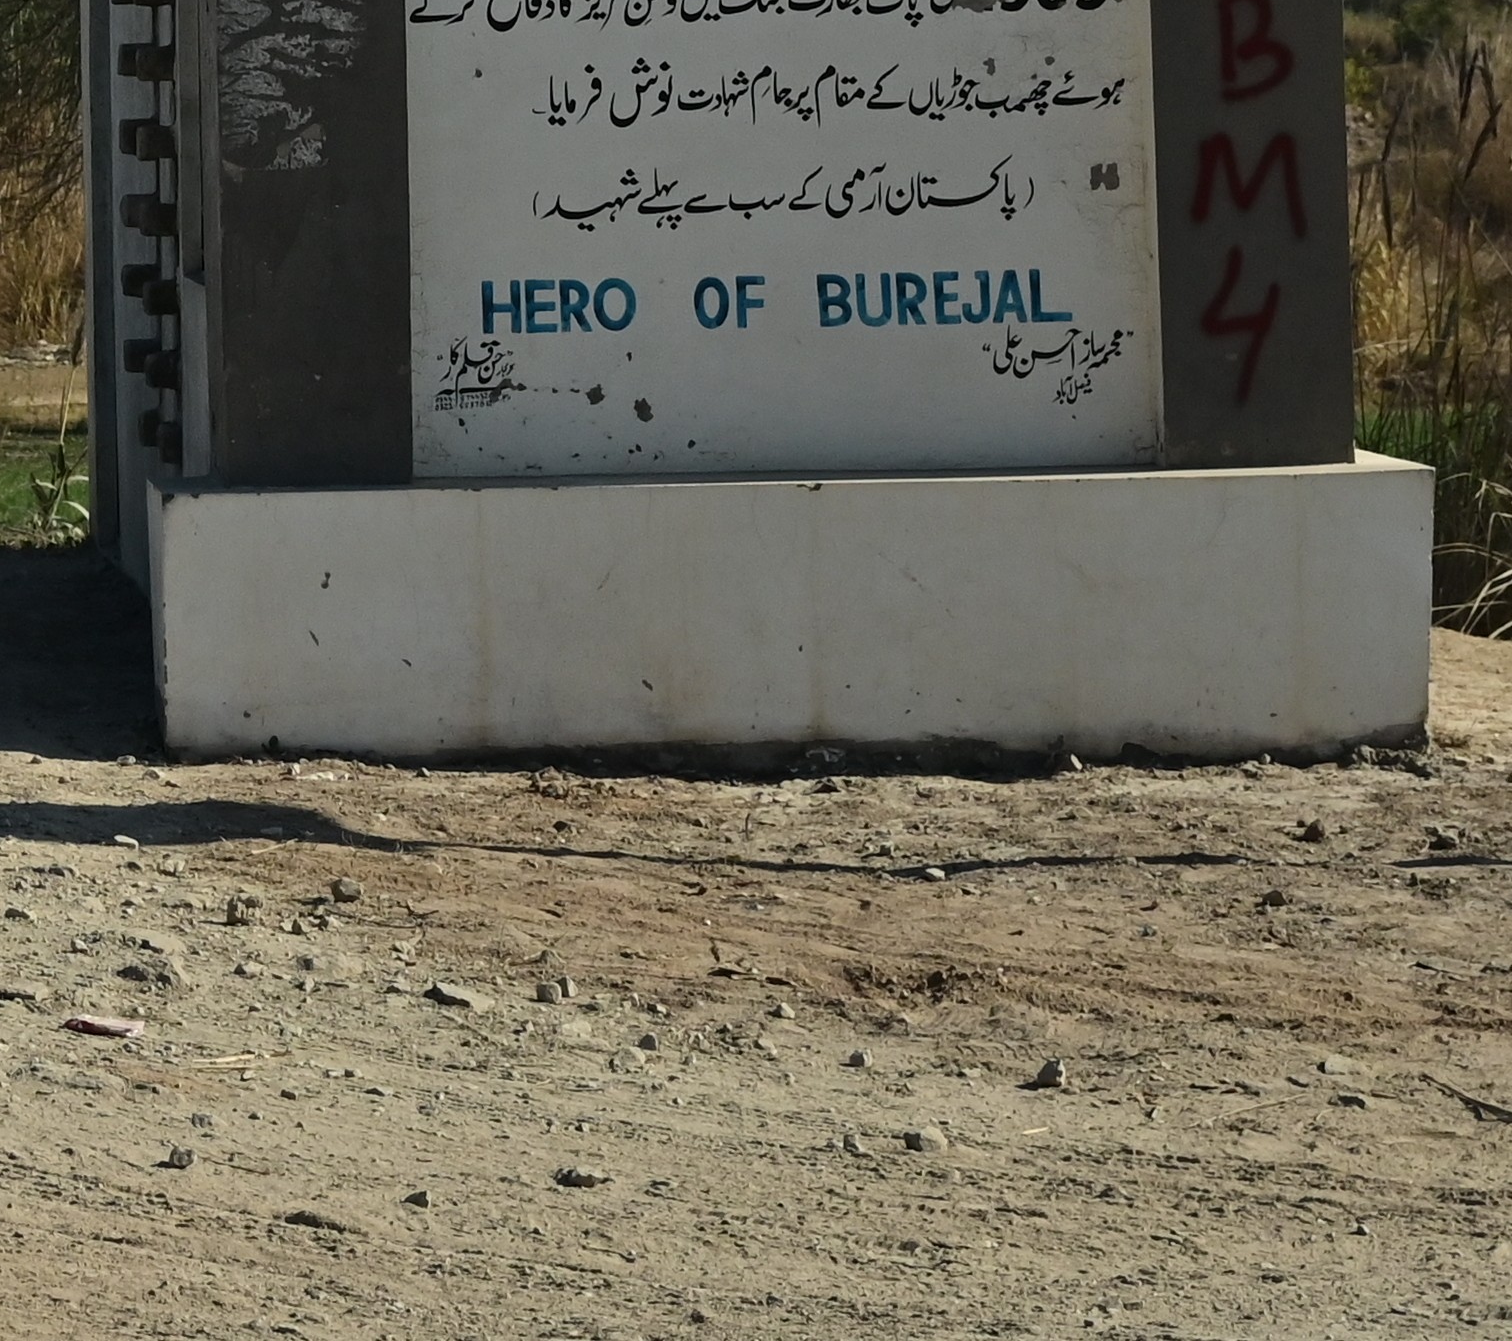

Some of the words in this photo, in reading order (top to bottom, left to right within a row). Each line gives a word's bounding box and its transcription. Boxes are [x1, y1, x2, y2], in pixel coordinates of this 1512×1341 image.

[609, 57, 673, 128] نوش
[677, 71, 749, 117] شہادت
[783, 86, 814, 121] پر
[814, 65, 866, 128] مقام
[867, 63, 906, 109] کے
[909, 67, 980, 121] جوڑیاں
[976, 79, 1052, 118] چھمب
[1052, 70, 1125, 109] ہوئے
[637, 167, 683, 230] پہلے
[683, 193, 729, 214] سے
[728, 193, 786, 220] سب
[788, 165, 823, 211] کے
[825, 162, 887, 219] آرمی
[480, 278, 637, 335] HERO
[693, 275, 765, 329] OF
[815, 269, 1073, 328] BUREJAL
